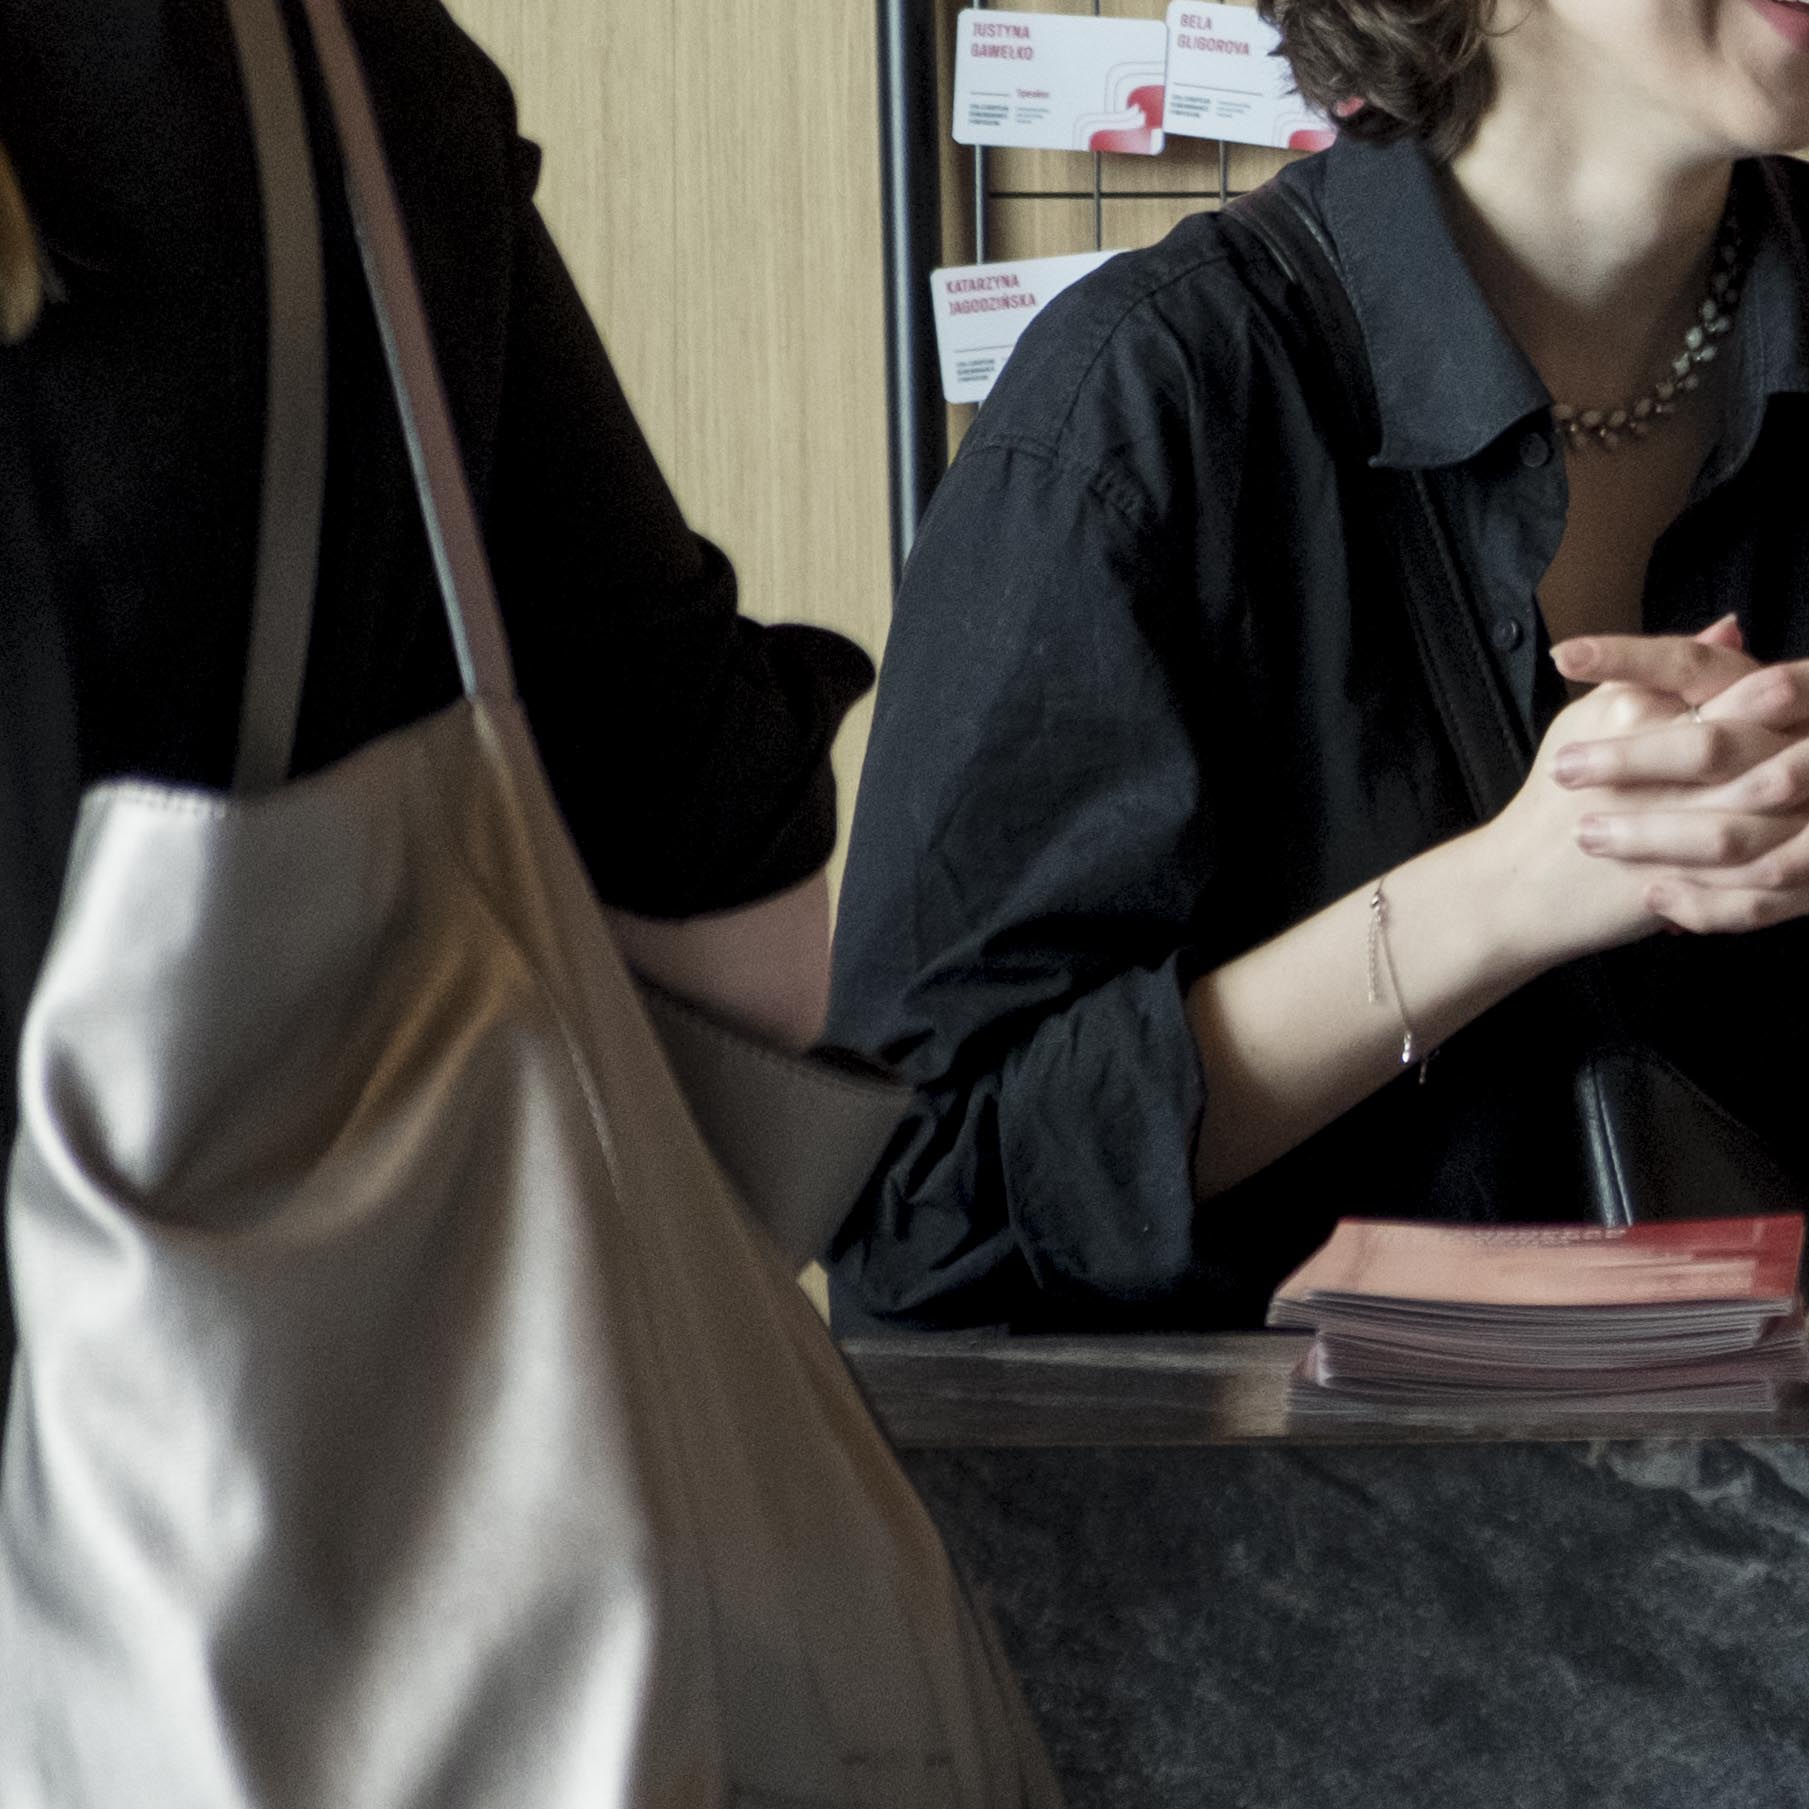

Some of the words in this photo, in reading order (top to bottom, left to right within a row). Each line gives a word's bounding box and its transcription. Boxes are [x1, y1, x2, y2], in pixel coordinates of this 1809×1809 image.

[973, 22, 1030, 39] JUSTYNA
[1180, 13, 1212, 31] BELA
[1176, 33, 1250, 56] GLIGOROVA
[945, 274, 1020, 294] KATARZYNA
